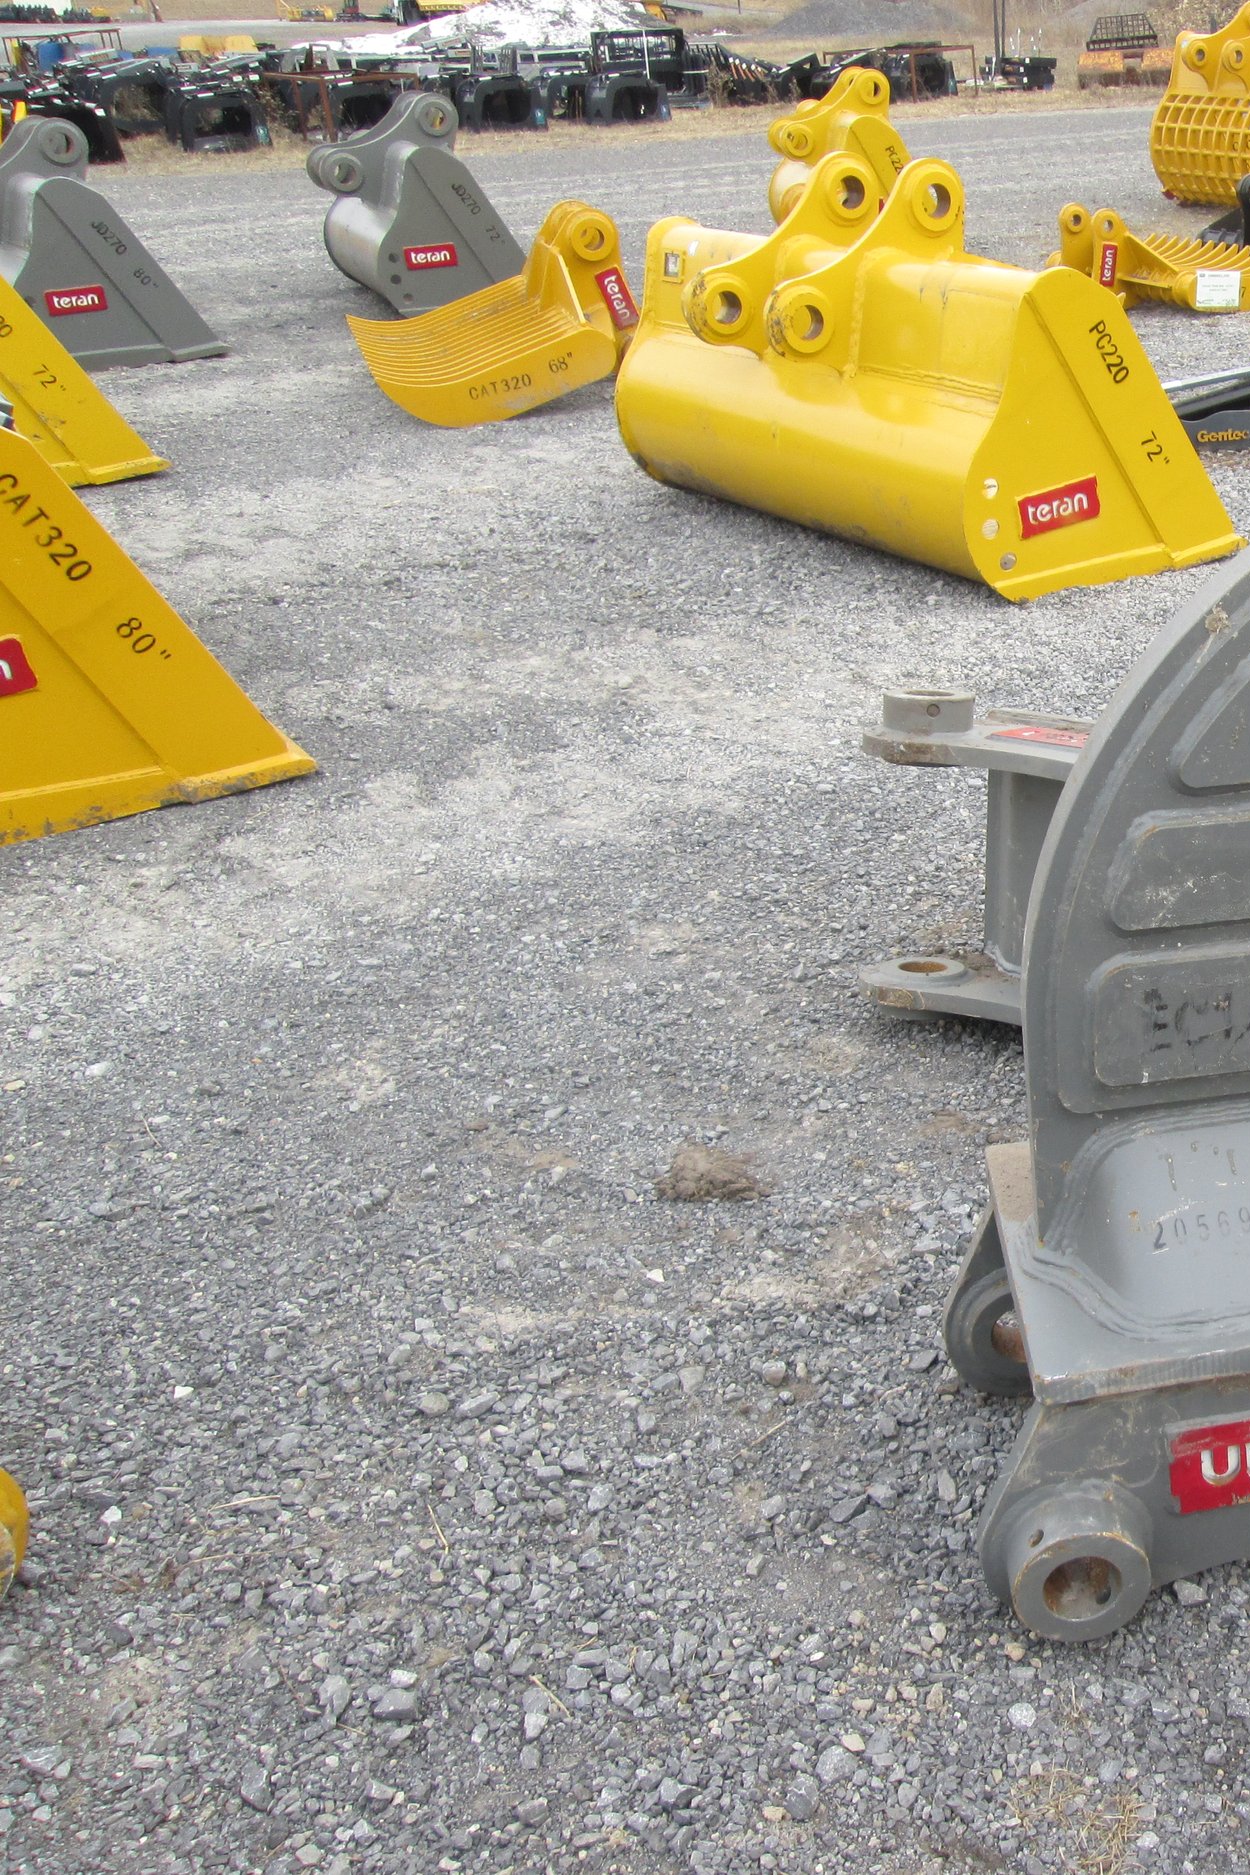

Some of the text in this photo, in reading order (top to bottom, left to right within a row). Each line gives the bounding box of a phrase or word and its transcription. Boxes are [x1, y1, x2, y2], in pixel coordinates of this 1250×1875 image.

[885, 146, 904, 175] PC22
[452, 183, 481, 215] JD270
[91, 221, 127, 255] JD270
[410, 250, 451, 264] teran
[1102, 249, 1115, 281] teran
[53, 293, 99, 309] teran
[603, 275, 631, 321] teran
[34, 364, 66, 391] 72"
[469, 352, 573, 400] CAT320 68"
[1088, 319, 1170, 465] PC220 72"
[1197, 428, 1250, 442] Gentec
[1027, 492, 1089, 525] teran
[0, 473, 172, 660] CAT320 80"
